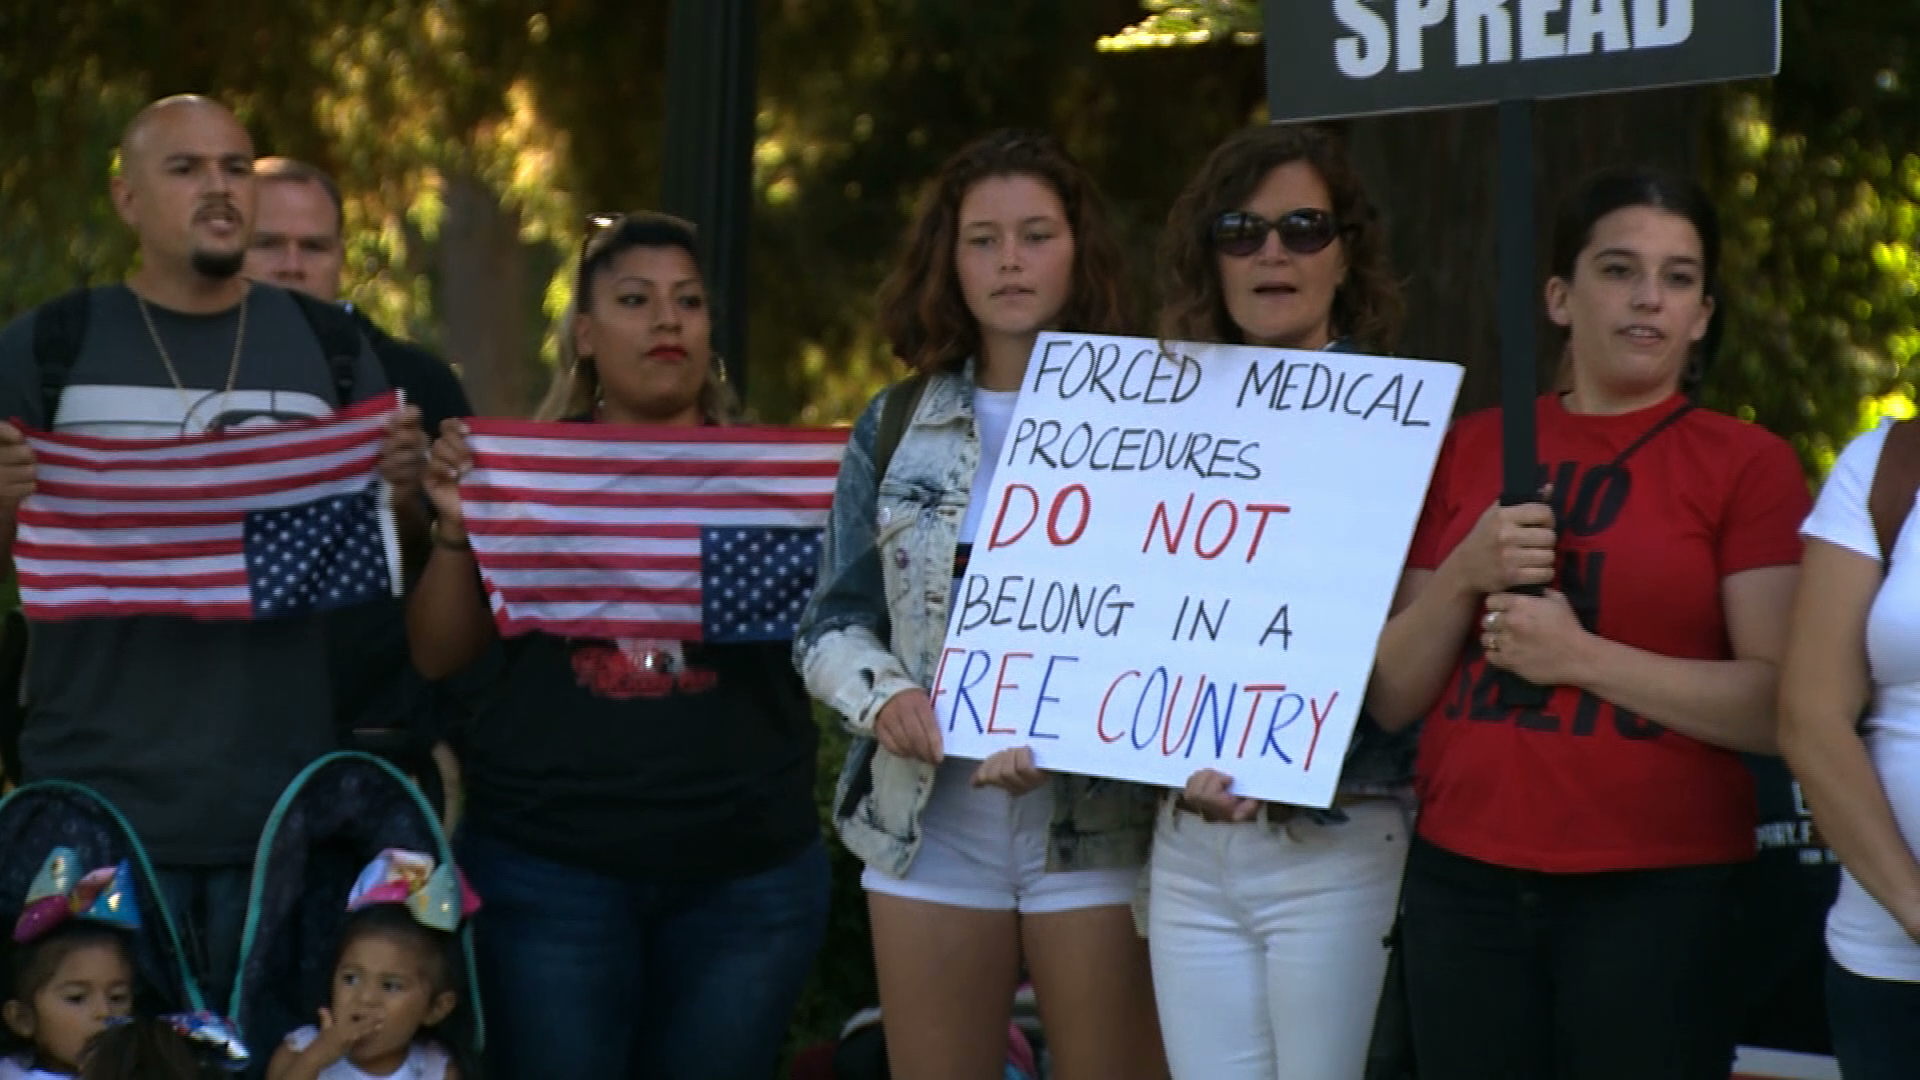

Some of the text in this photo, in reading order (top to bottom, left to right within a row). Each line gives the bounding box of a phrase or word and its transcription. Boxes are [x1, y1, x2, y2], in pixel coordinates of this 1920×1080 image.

[1332, 0, 1694, 79] SPREAD
[1032, 340, 1431, 427] FORCED MEDICAL
[1007, 417, 1262, 481] PROCEDURES
[987, 483, 1291, 563] DO NOT
[956, 575, 1293, 651] BELONG IN A
[930, 647, 1079, 740] FREE
[1097, 667, 1338, 771] COUNTRY
